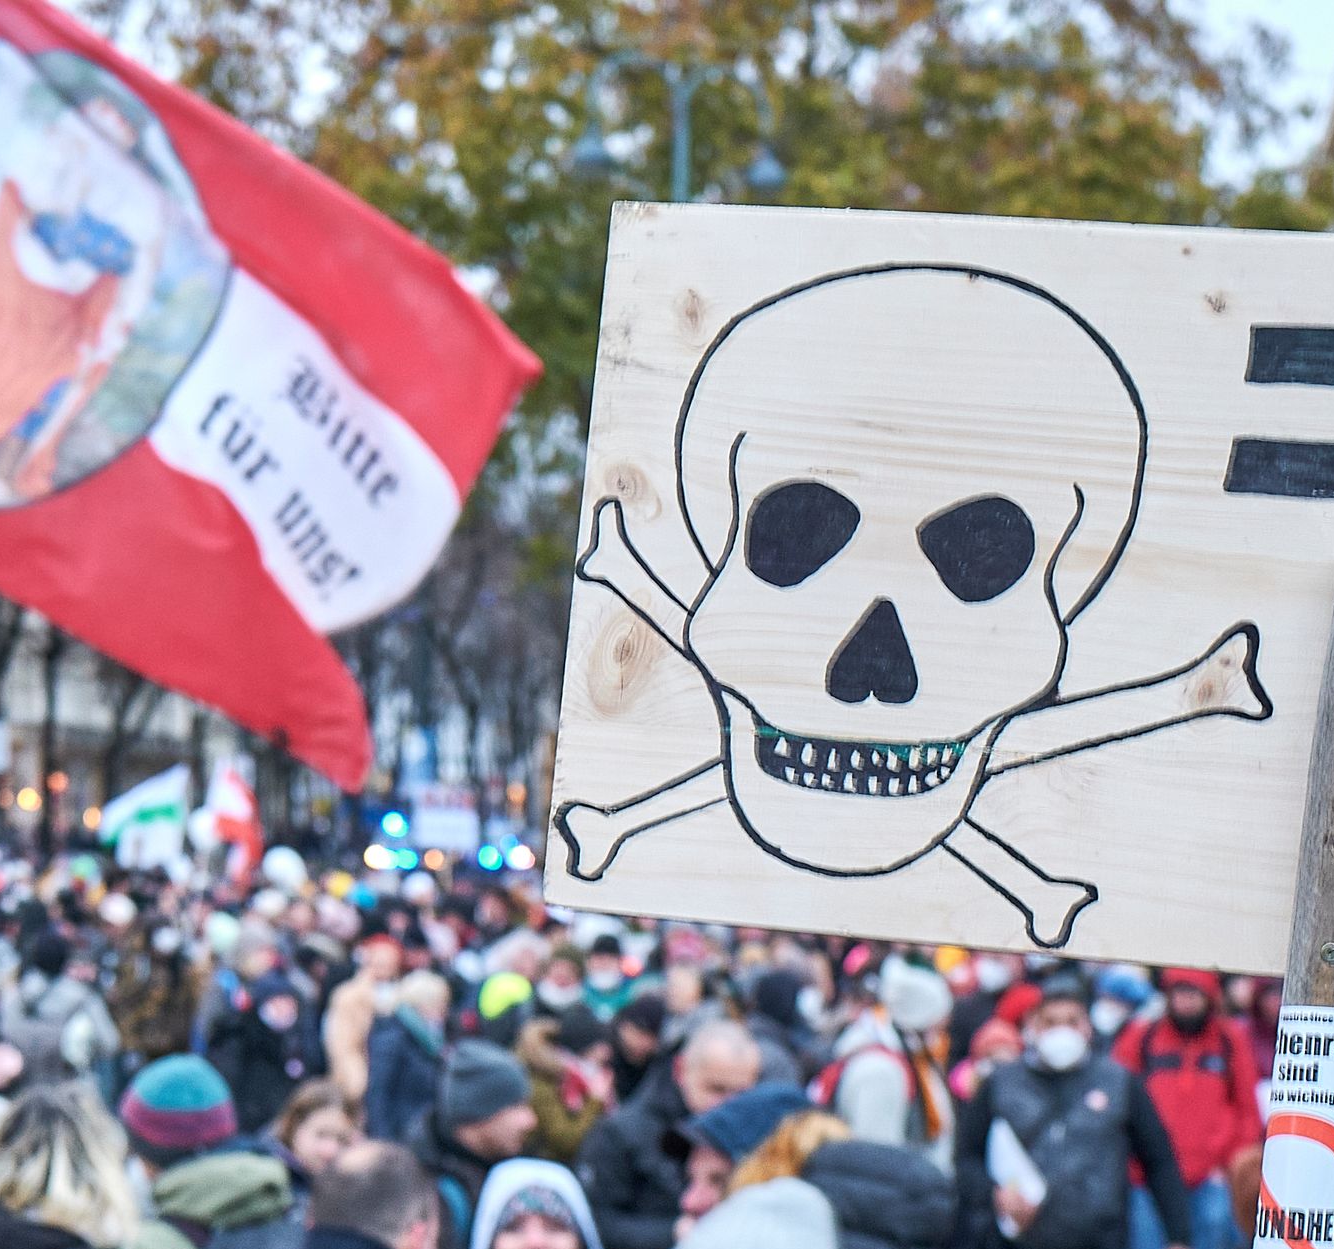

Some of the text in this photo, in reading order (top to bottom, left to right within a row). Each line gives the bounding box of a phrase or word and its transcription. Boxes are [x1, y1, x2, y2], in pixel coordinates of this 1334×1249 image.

[198, 390, 281, 484] für
[285, 354, 399, 508] Bitte
[1278, 1061, 1319, 1082] sind
